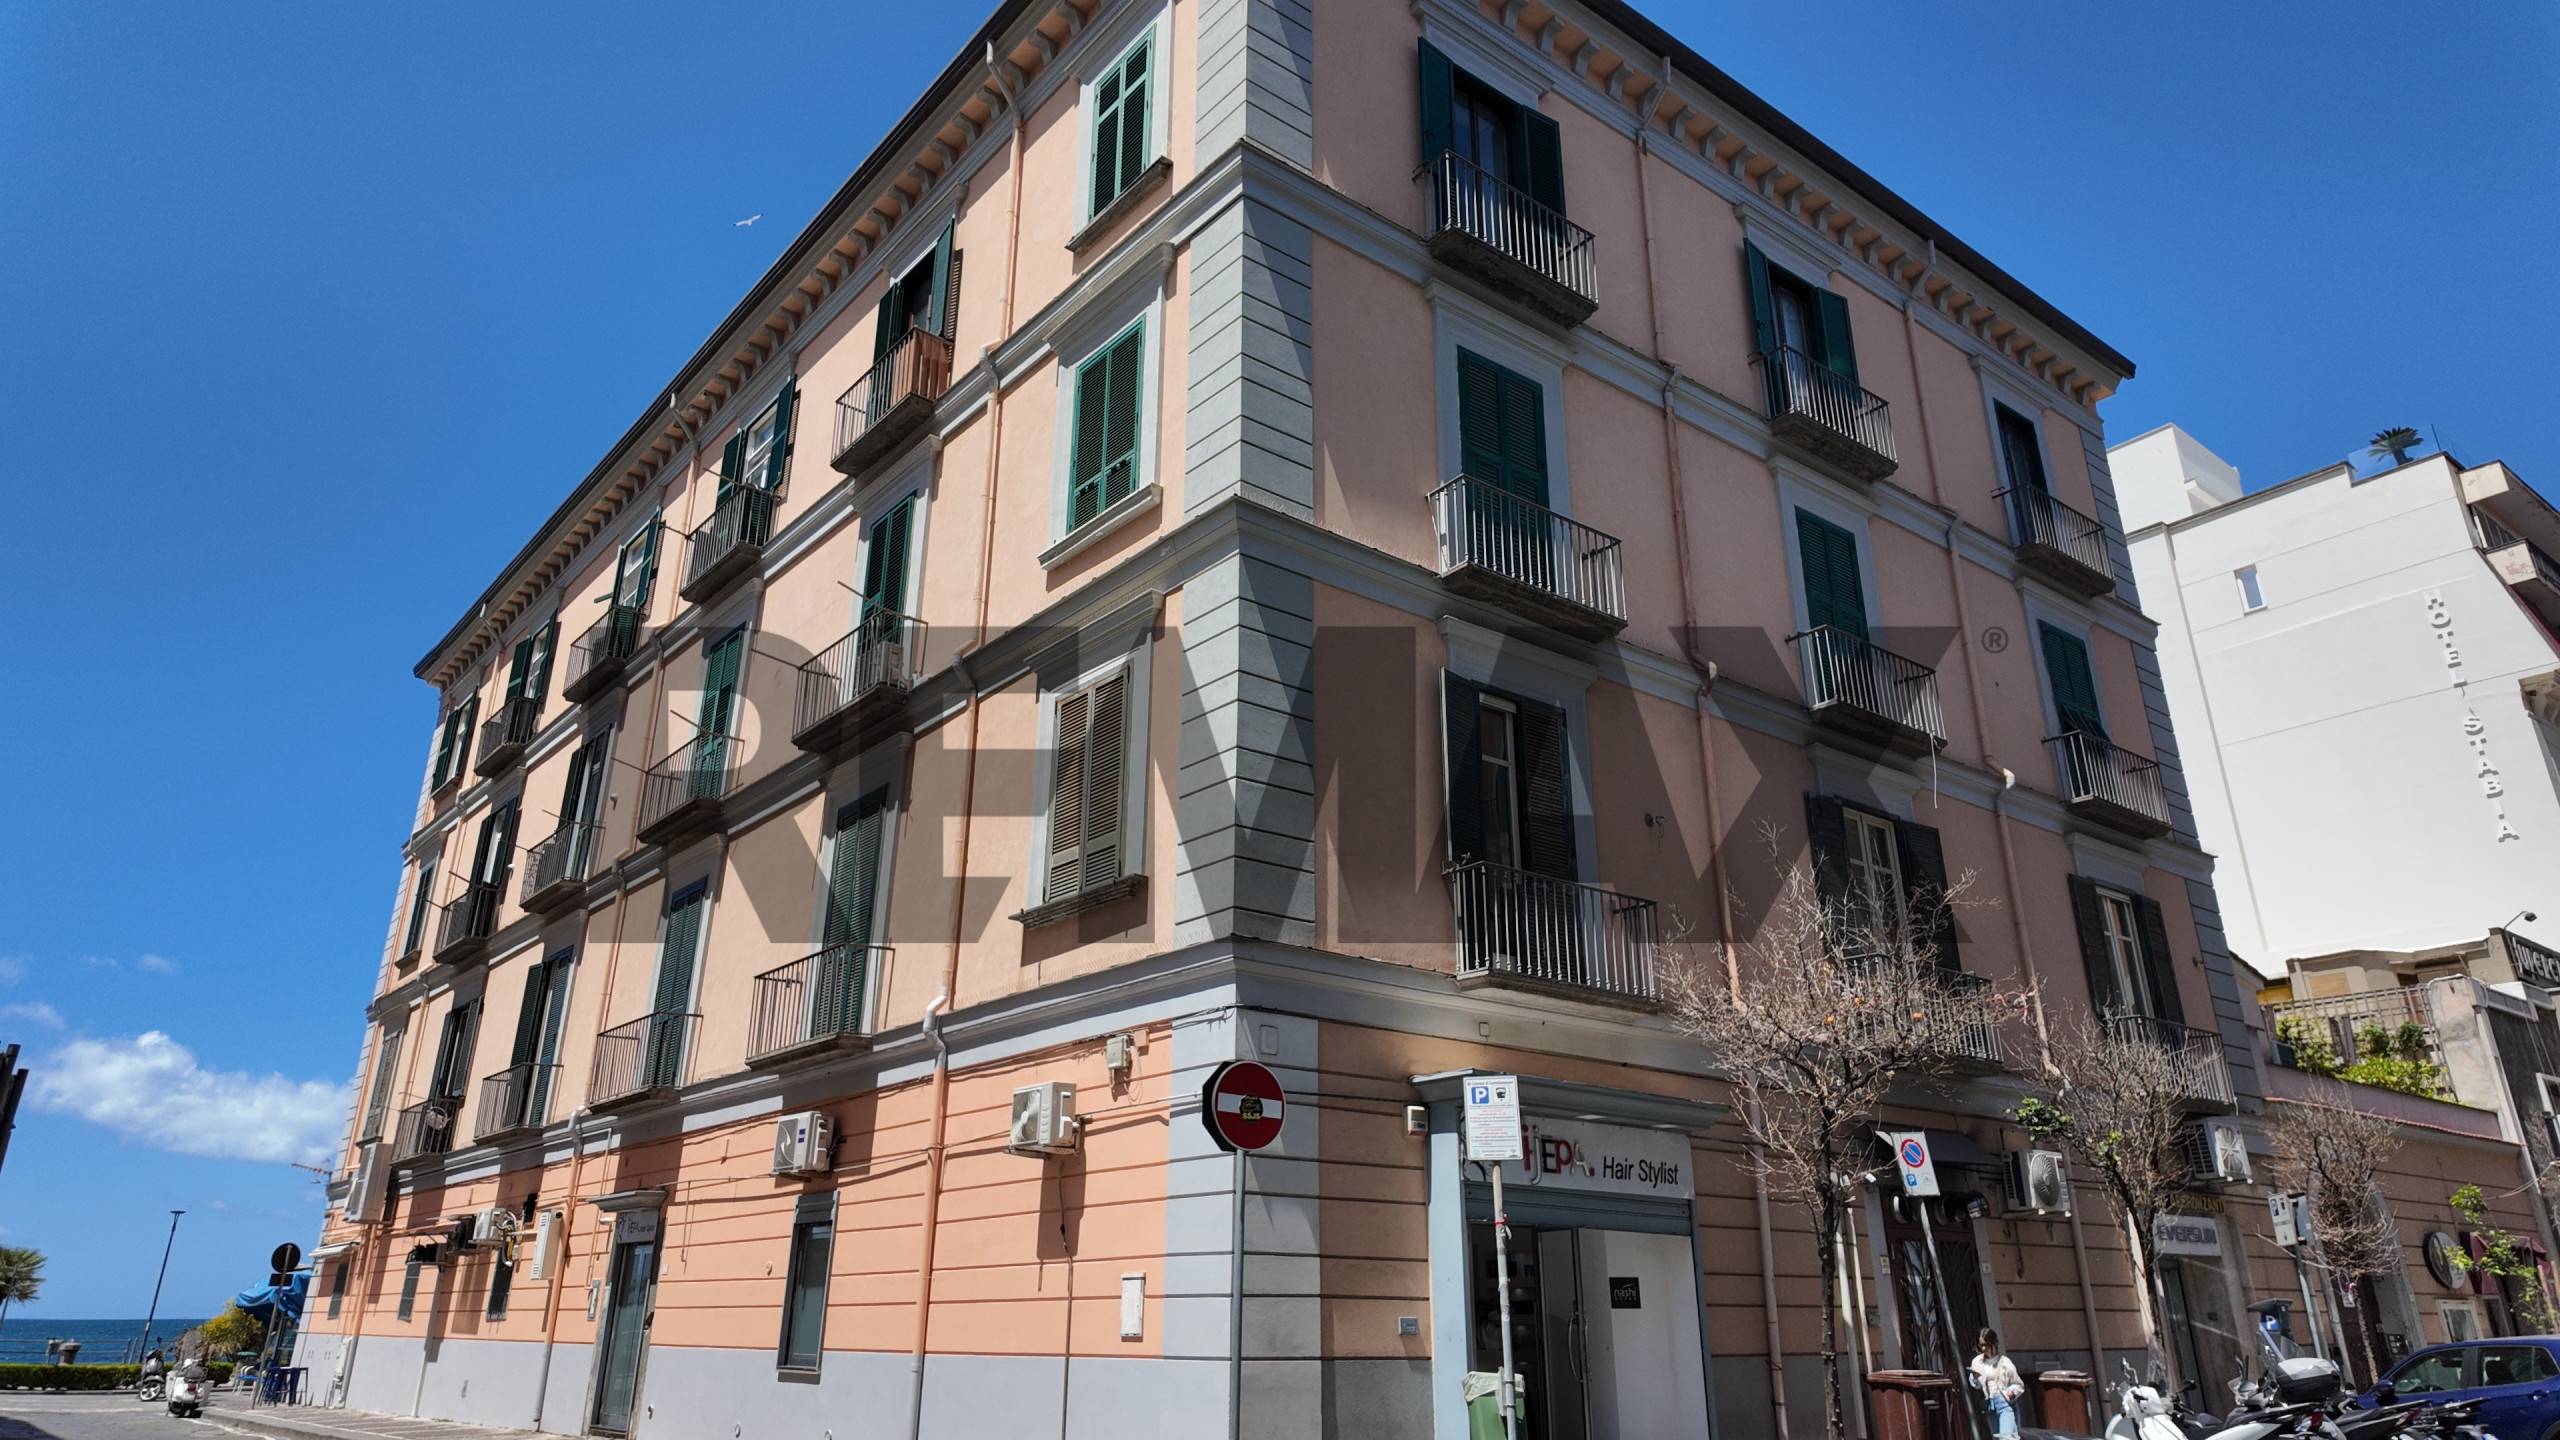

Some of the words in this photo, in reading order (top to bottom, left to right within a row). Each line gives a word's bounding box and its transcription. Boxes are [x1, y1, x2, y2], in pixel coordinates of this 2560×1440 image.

[2424, 589, 2468, 688] HOTEL
[2463, 715, 2520, 842] STABIA
[1602, 1155, 1635, 1180] Hair
[1638, 1158, 1679, 1189] Stylist
